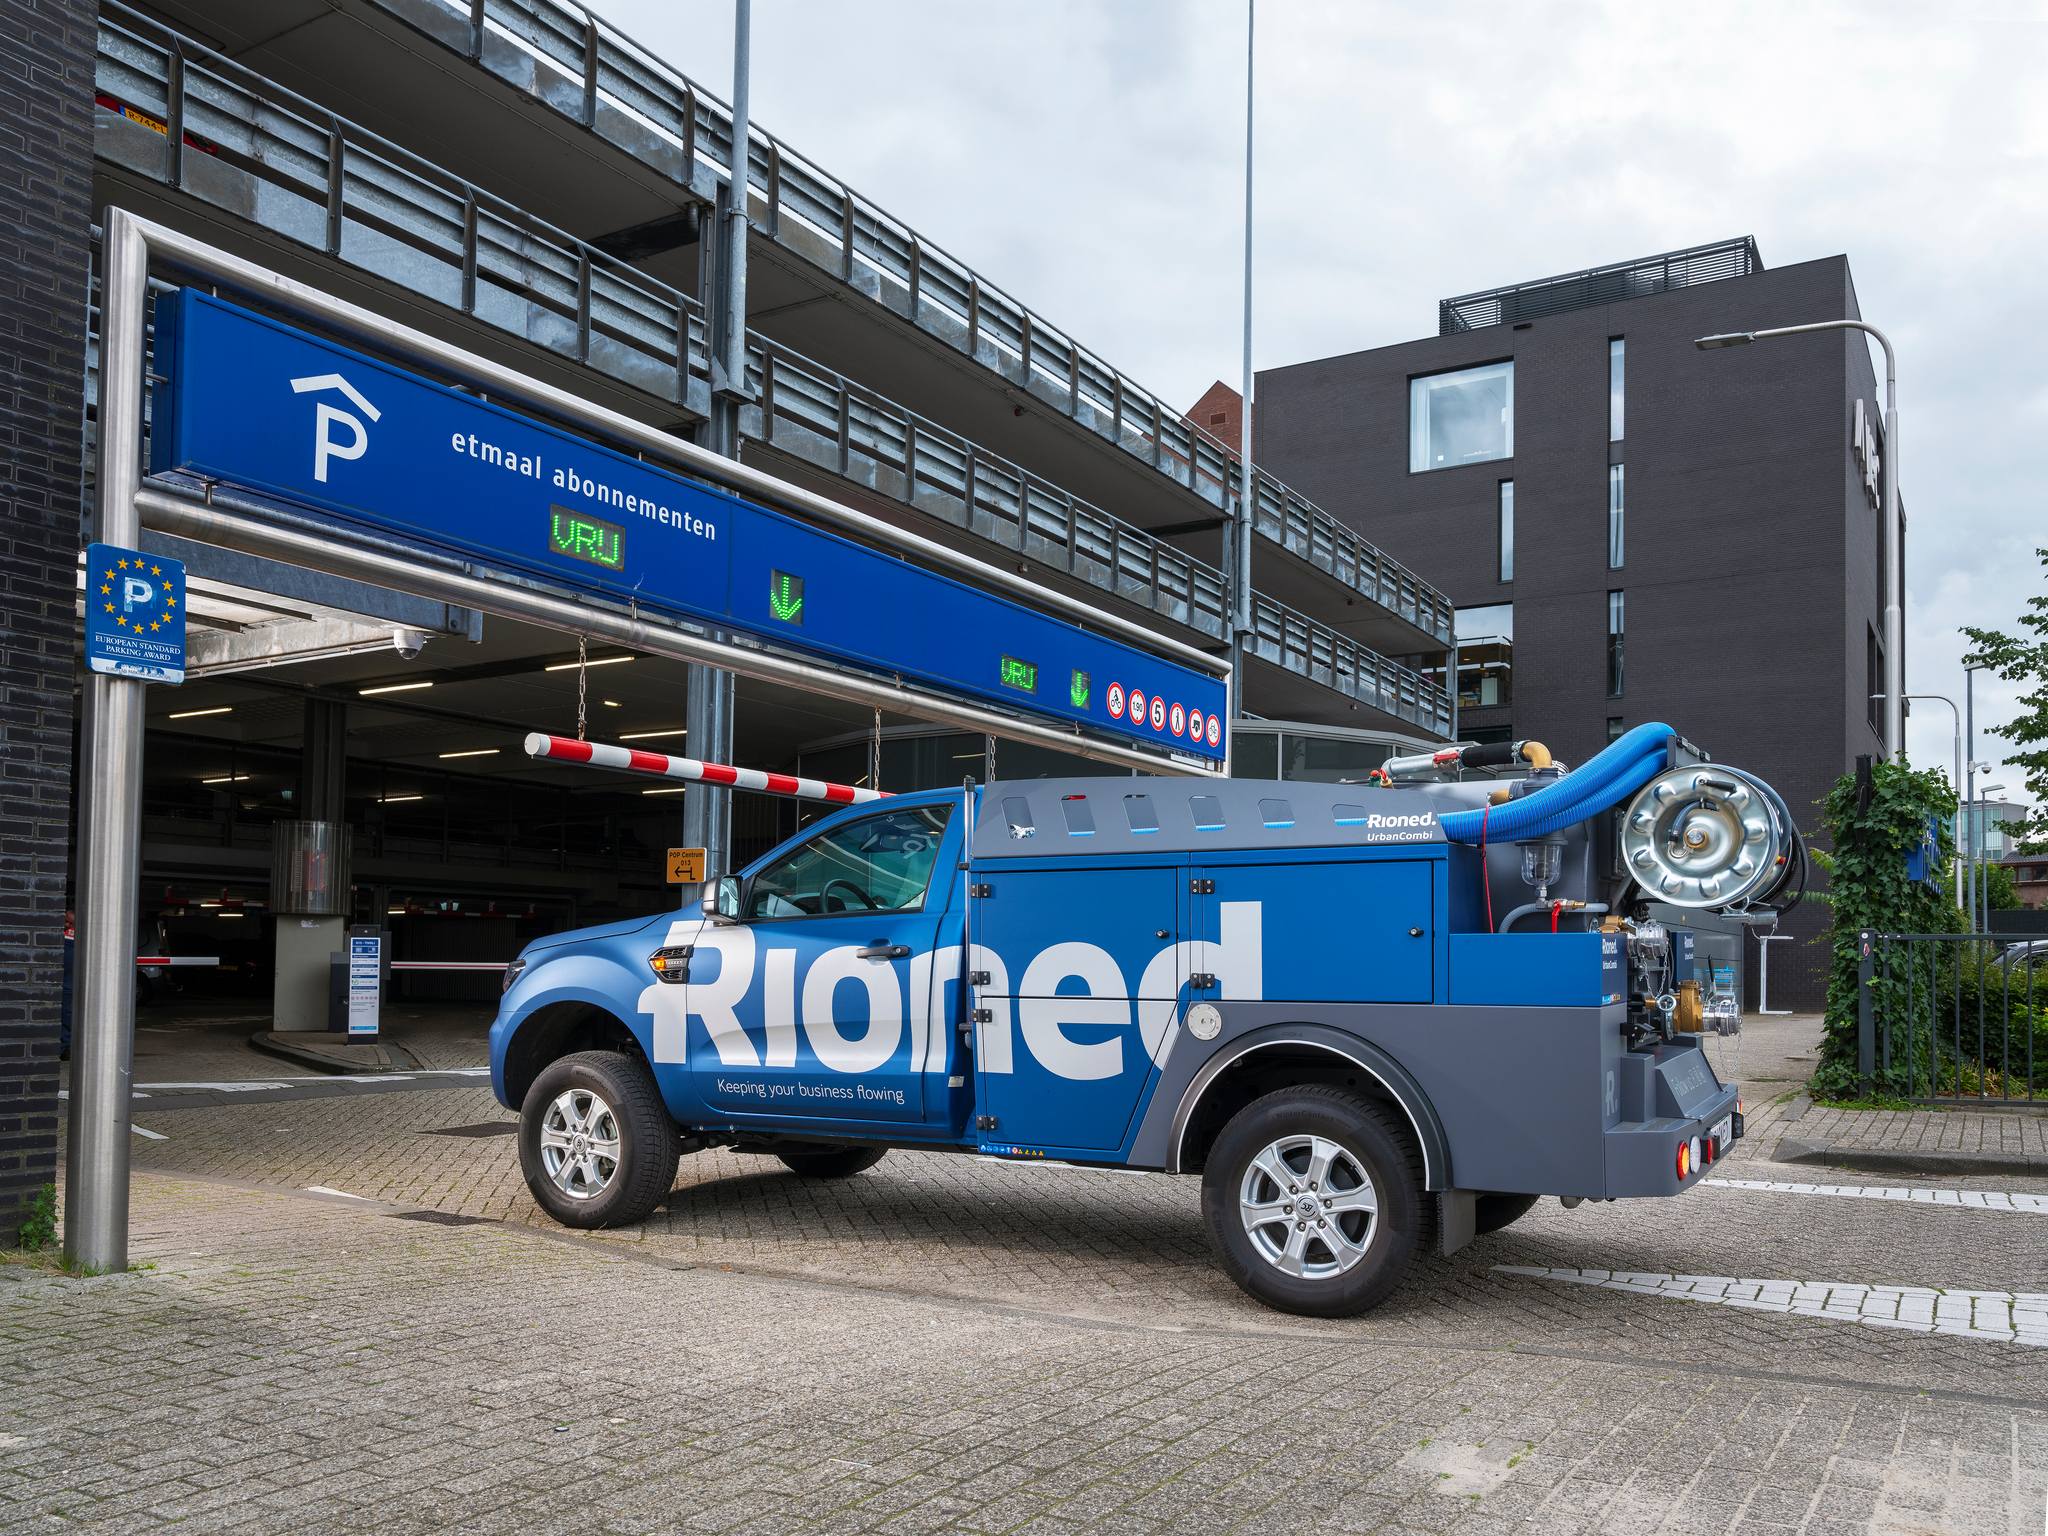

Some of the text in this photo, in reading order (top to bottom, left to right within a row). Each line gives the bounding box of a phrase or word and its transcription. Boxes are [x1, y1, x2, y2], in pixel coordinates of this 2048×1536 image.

[451, 431, 717, 541] etmaal abonnementen
[124, 576, 153, 613] P
[95, 635, 181, 655] EUROPEAN STANDARD
[106, 645, 171, 661] PARKING AWARD
[1154, 703, 1162, 723] 5
[1367, 830, 1433, 842] UrbanCombi
[717, 1079, 905, 1105] Keeping your business flowing
